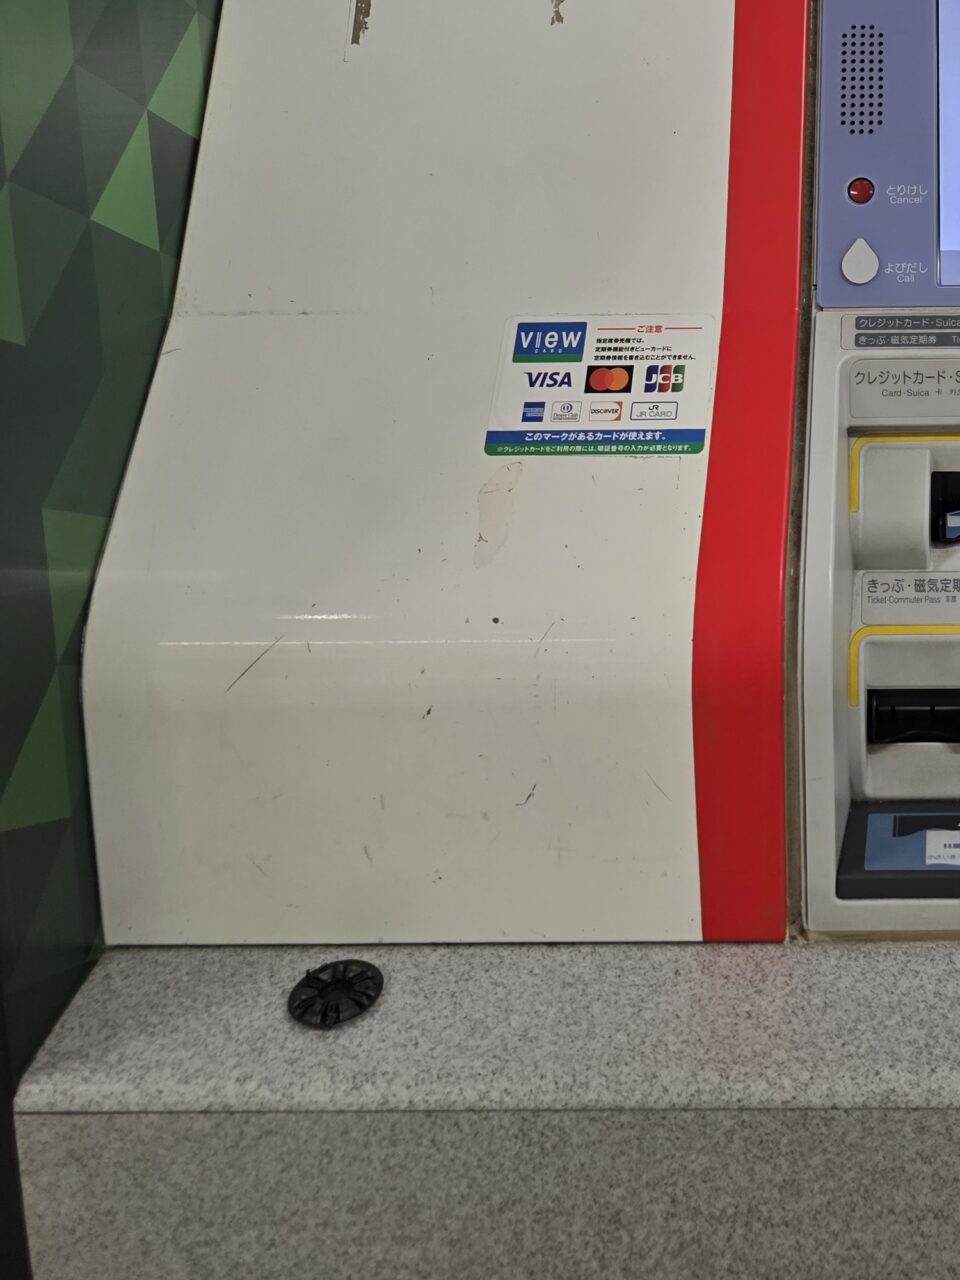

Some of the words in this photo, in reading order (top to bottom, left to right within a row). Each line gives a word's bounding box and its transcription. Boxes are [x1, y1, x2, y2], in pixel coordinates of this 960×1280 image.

[886, 184, 928, 196] とりけし
[889, 196, 922, 205] Cancel
[884, 262, 928, 274] よびだし
[896, 274, 915, 283] Call
[636, 324, 663, 333] ご注意
[523, 371, 572, 388] VISA
[525, 431, 666, 441] このマークがあるカードが使えます。
[924, 595, 941, 604] Pass
